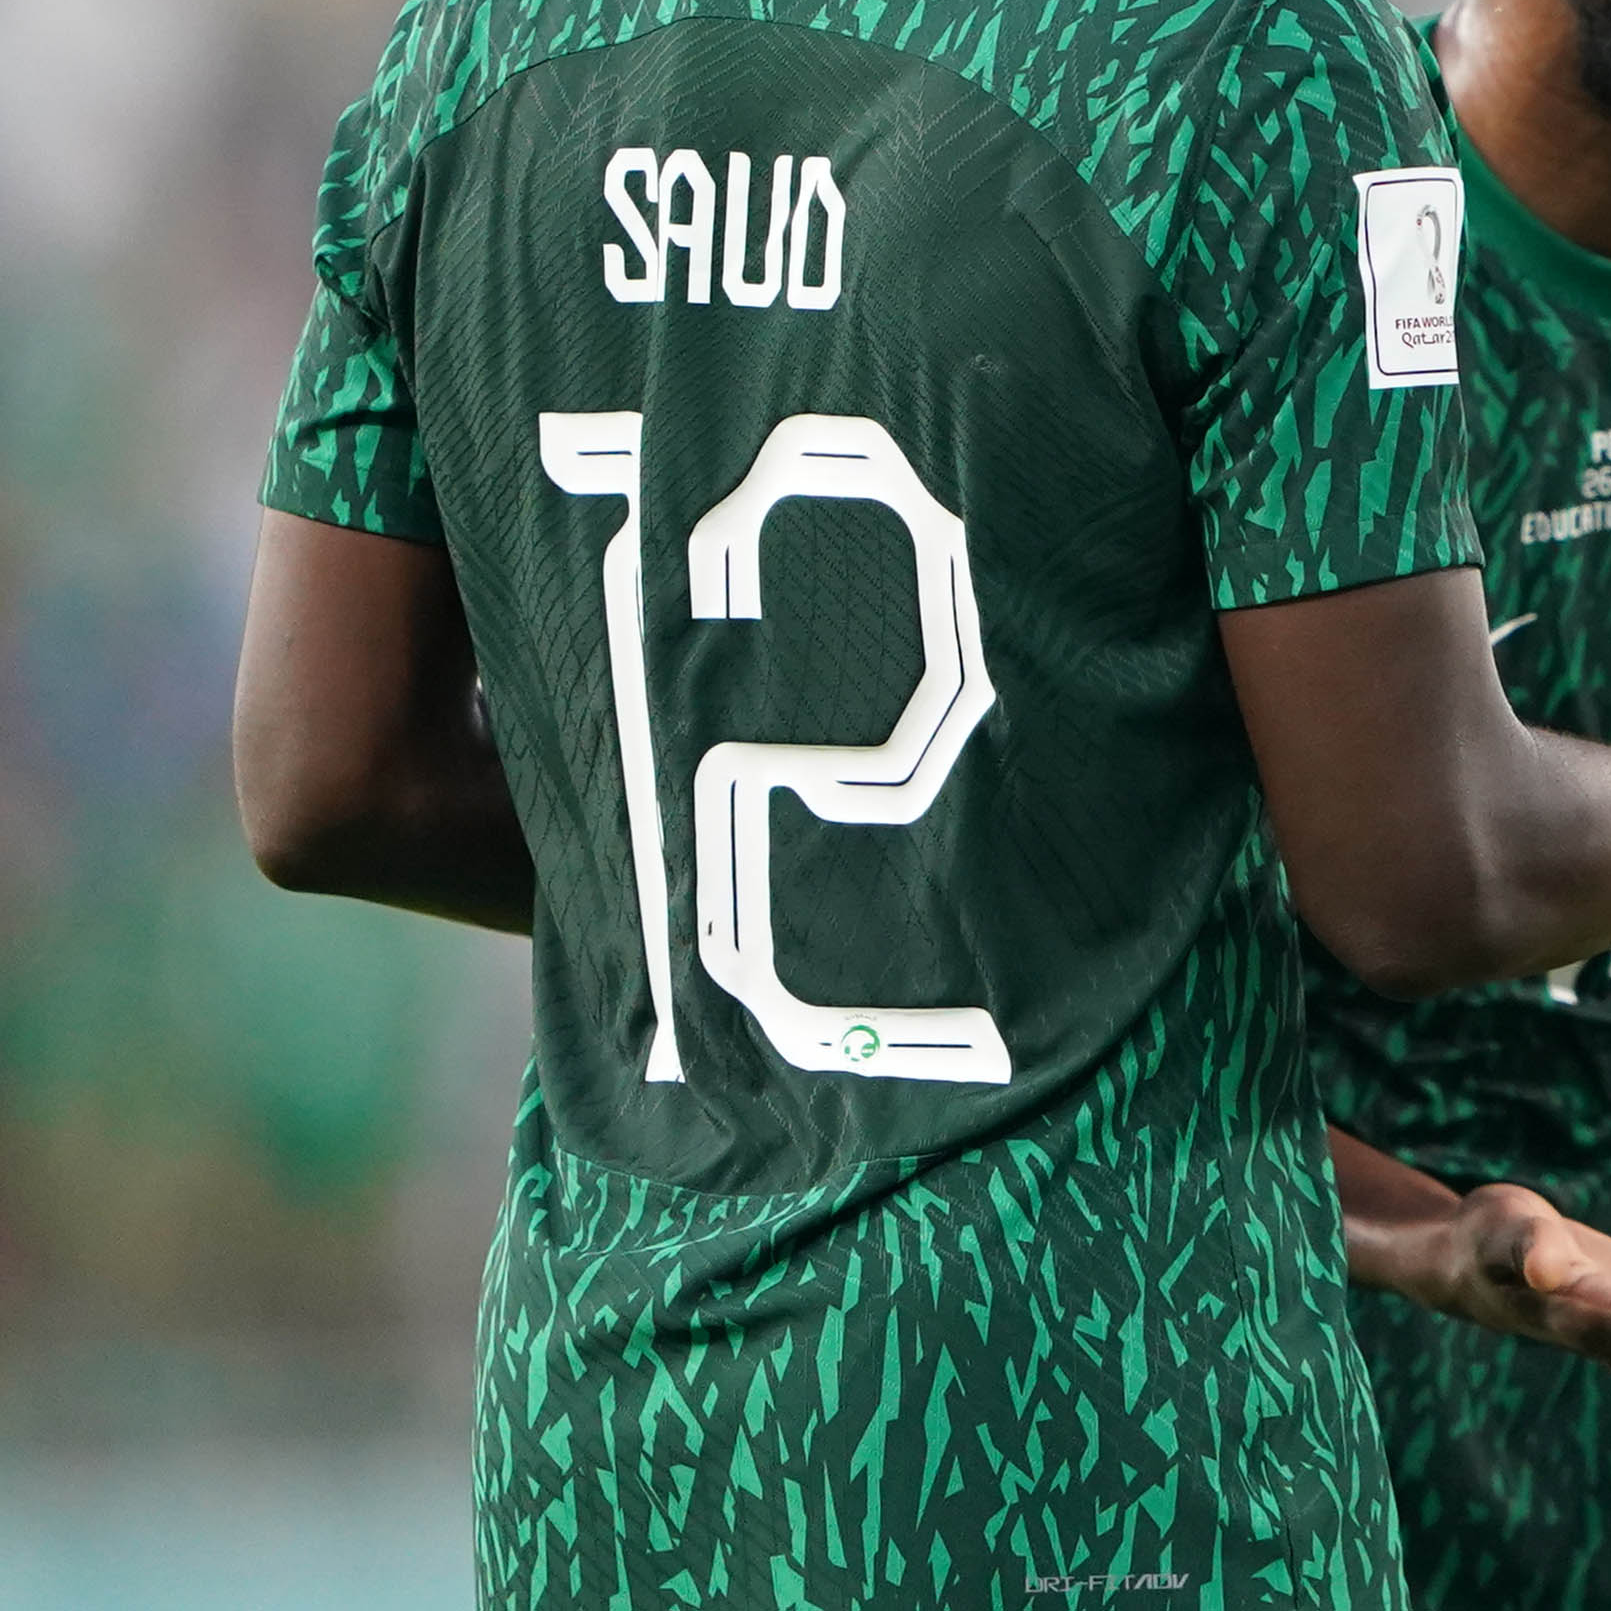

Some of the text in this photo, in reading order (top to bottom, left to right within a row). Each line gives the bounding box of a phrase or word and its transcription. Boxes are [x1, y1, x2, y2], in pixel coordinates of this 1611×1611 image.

[602, 146, 847, 311] SAUD
[1394, 317, 1421, 330] FIFA
[538, 410, 1013, 1085] 12
